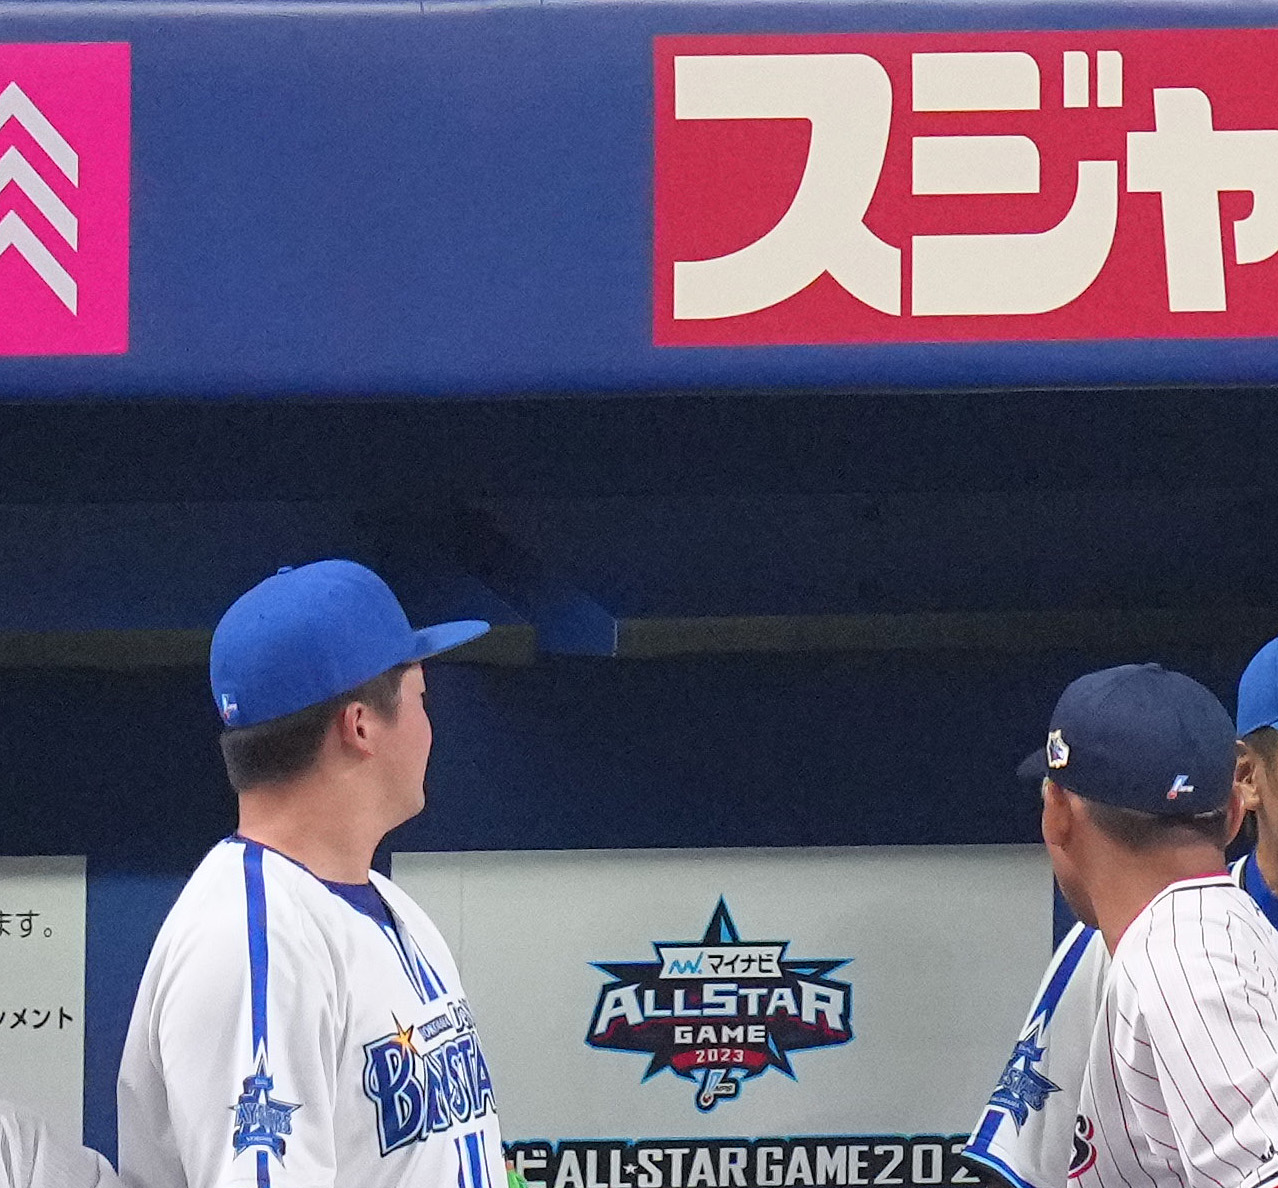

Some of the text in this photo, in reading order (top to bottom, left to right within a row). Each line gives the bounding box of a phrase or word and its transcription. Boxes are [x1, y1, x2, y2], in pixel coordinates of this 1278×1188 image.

[707, 953, 775, 975] マイナビ
[0, 1006, 73, 1029] メント
[673, 1025, 766, 1045] GAME
[695, 1050, 745, 1064] 2023
